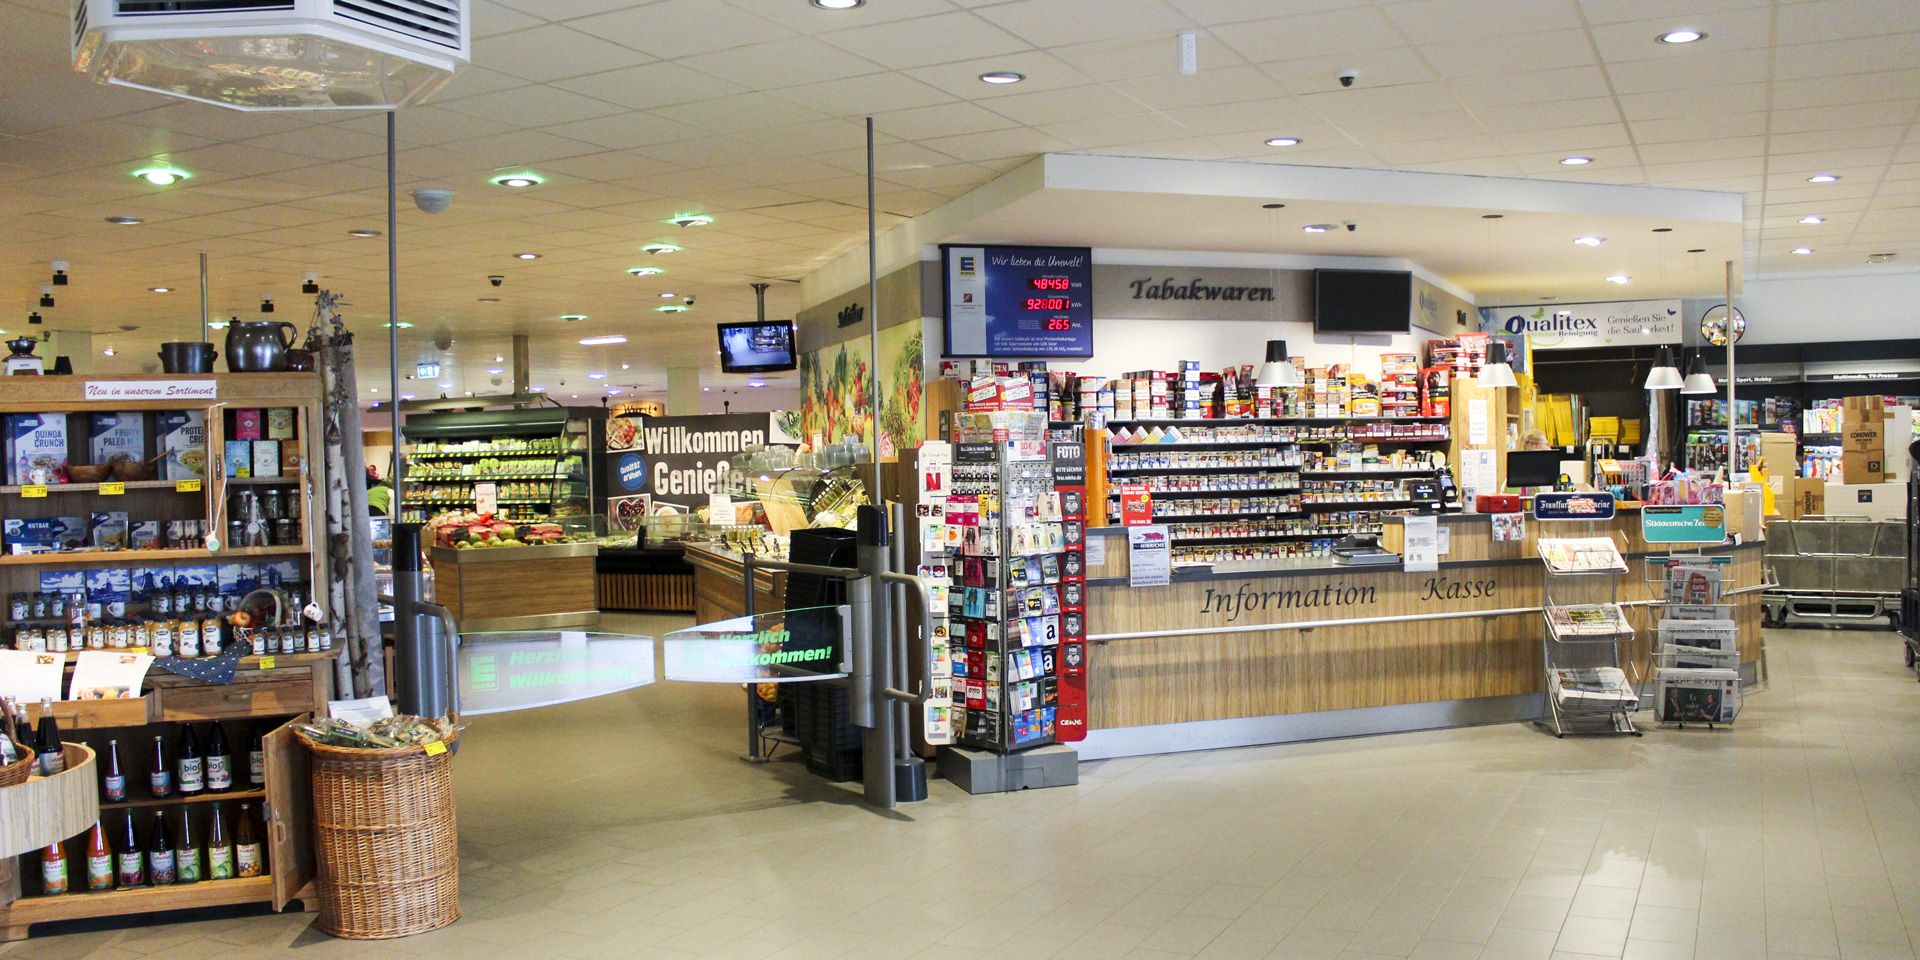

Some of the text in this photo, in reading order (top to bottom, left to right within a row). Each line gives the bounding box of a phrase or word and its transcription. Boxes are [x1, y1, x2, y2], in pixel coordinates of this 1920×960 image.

[992, 255, 1084, 267] Wir lieben die Umwelt!
[1034, 278, 1069, 290] 48458
[1129, 278, 1275, 302] Tabakwaren
[1505, 313, 1597, 335] Qualitex
[1607, 313, 1666, 324] Genießen Sie
[1048, 319, 1070, 330] 265
[1607, 325, 1621, 335] die
[1558, 330, 1598, 338] Reinigung
[88, 385, 214, 395] Neu in unserem Sortiment
[35, 430, 62, 439] QUINOA
[181, 426, 204, 435] PROTEI
[34, 438, 64, 447] CRUNCH
[1056, 445, 1081, 459] FOTO
[1646, 518, 1693, 528] Süddeutsche
[1200, 577, 1496, 621] Information Kasse
[1046, 624, 1056, 640] a
[1044, 654, 1053, 670] a
[251, 755, 264, 764] bio
